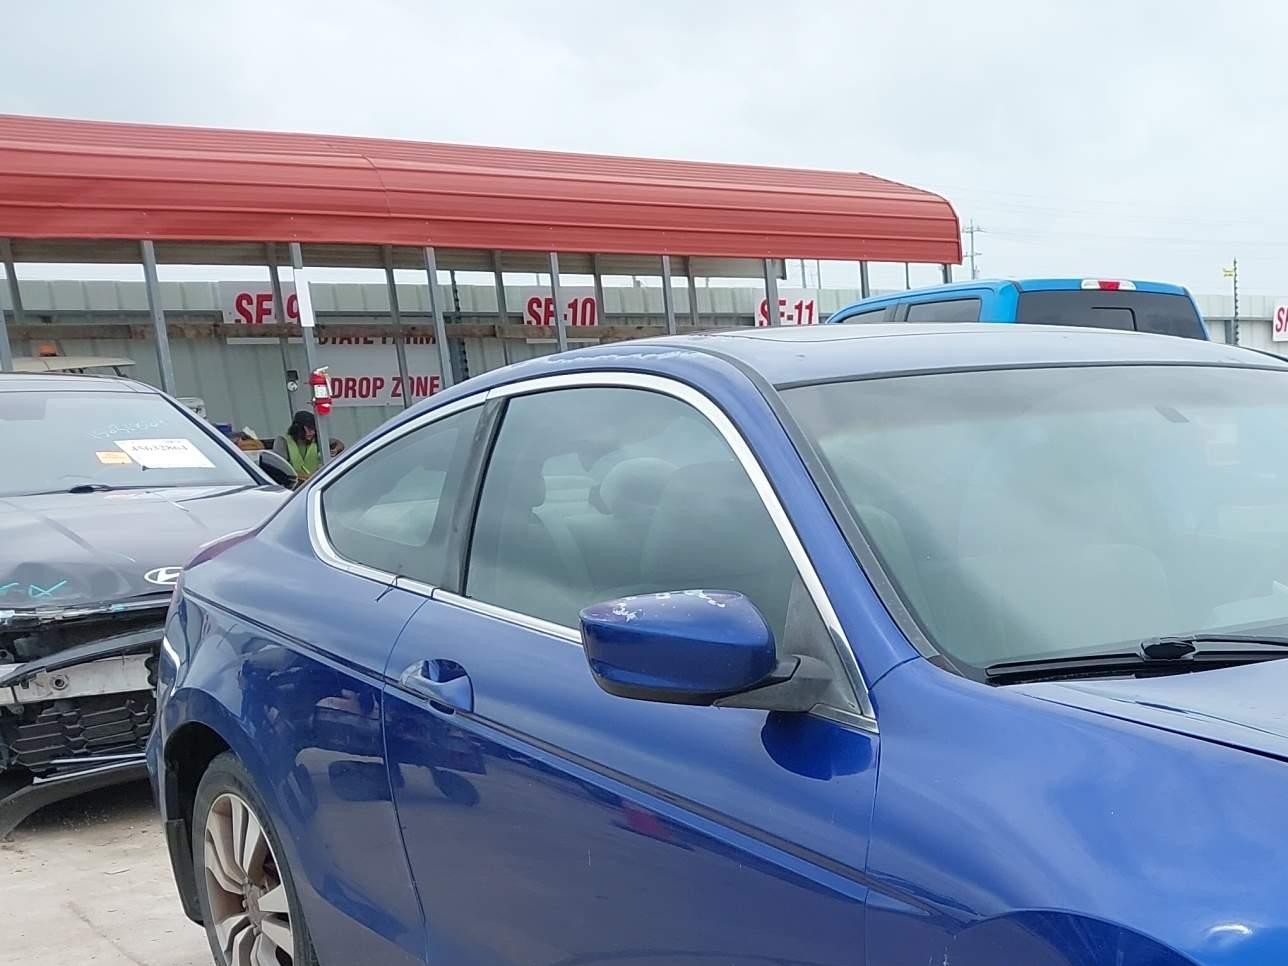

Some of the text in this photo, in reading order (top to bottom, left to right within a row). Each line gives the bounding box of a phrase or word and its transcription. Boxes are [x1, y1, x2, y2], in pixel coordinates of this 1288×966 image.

[234, 292, 300, 324] SF9
[331, 375, 440, 399] DROP ZNE
